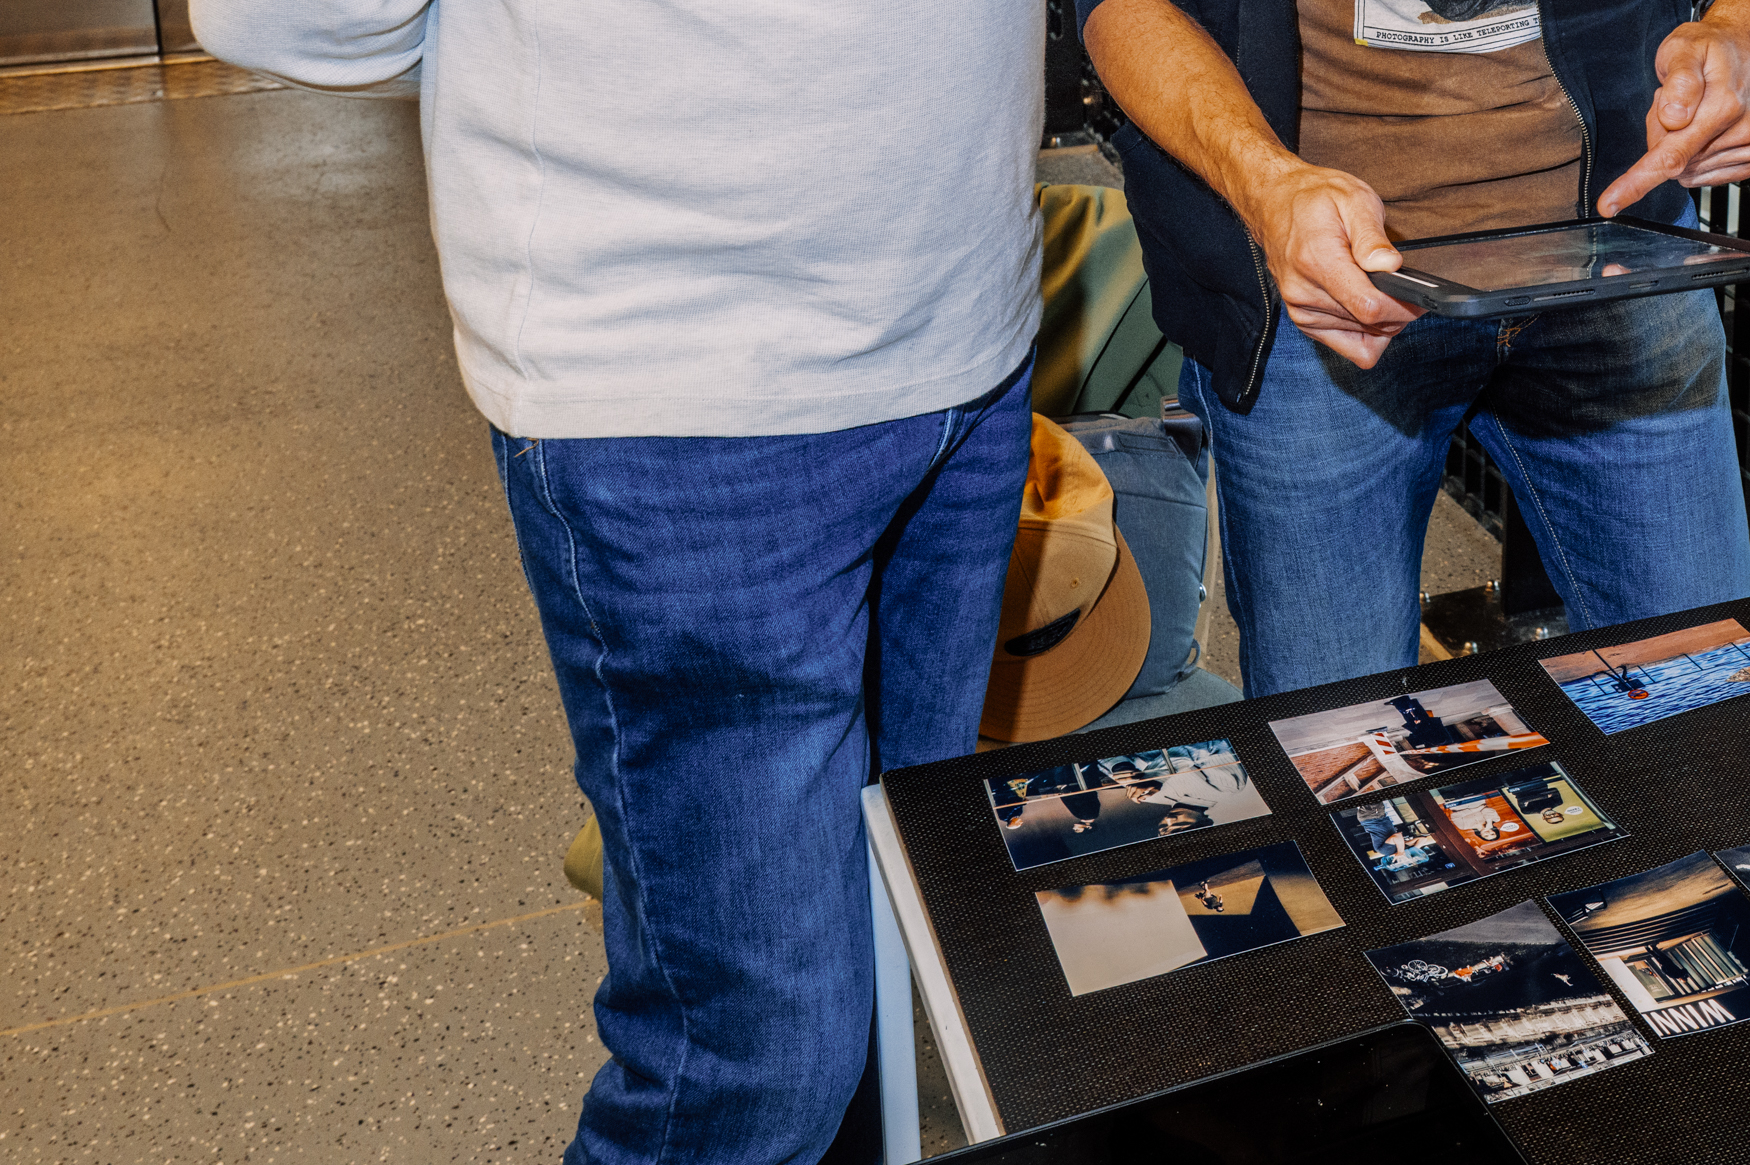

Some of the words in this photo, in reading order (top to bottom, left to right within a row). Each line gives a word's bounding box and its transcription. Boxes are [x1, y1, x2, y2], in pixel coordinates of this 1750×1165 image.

[1376, 31, 1435, 44] PHOTOGRAPHY
[1453, 31, 1473, 41] LIKE
[1476, 19, 1530, 37] TELEPORTING
